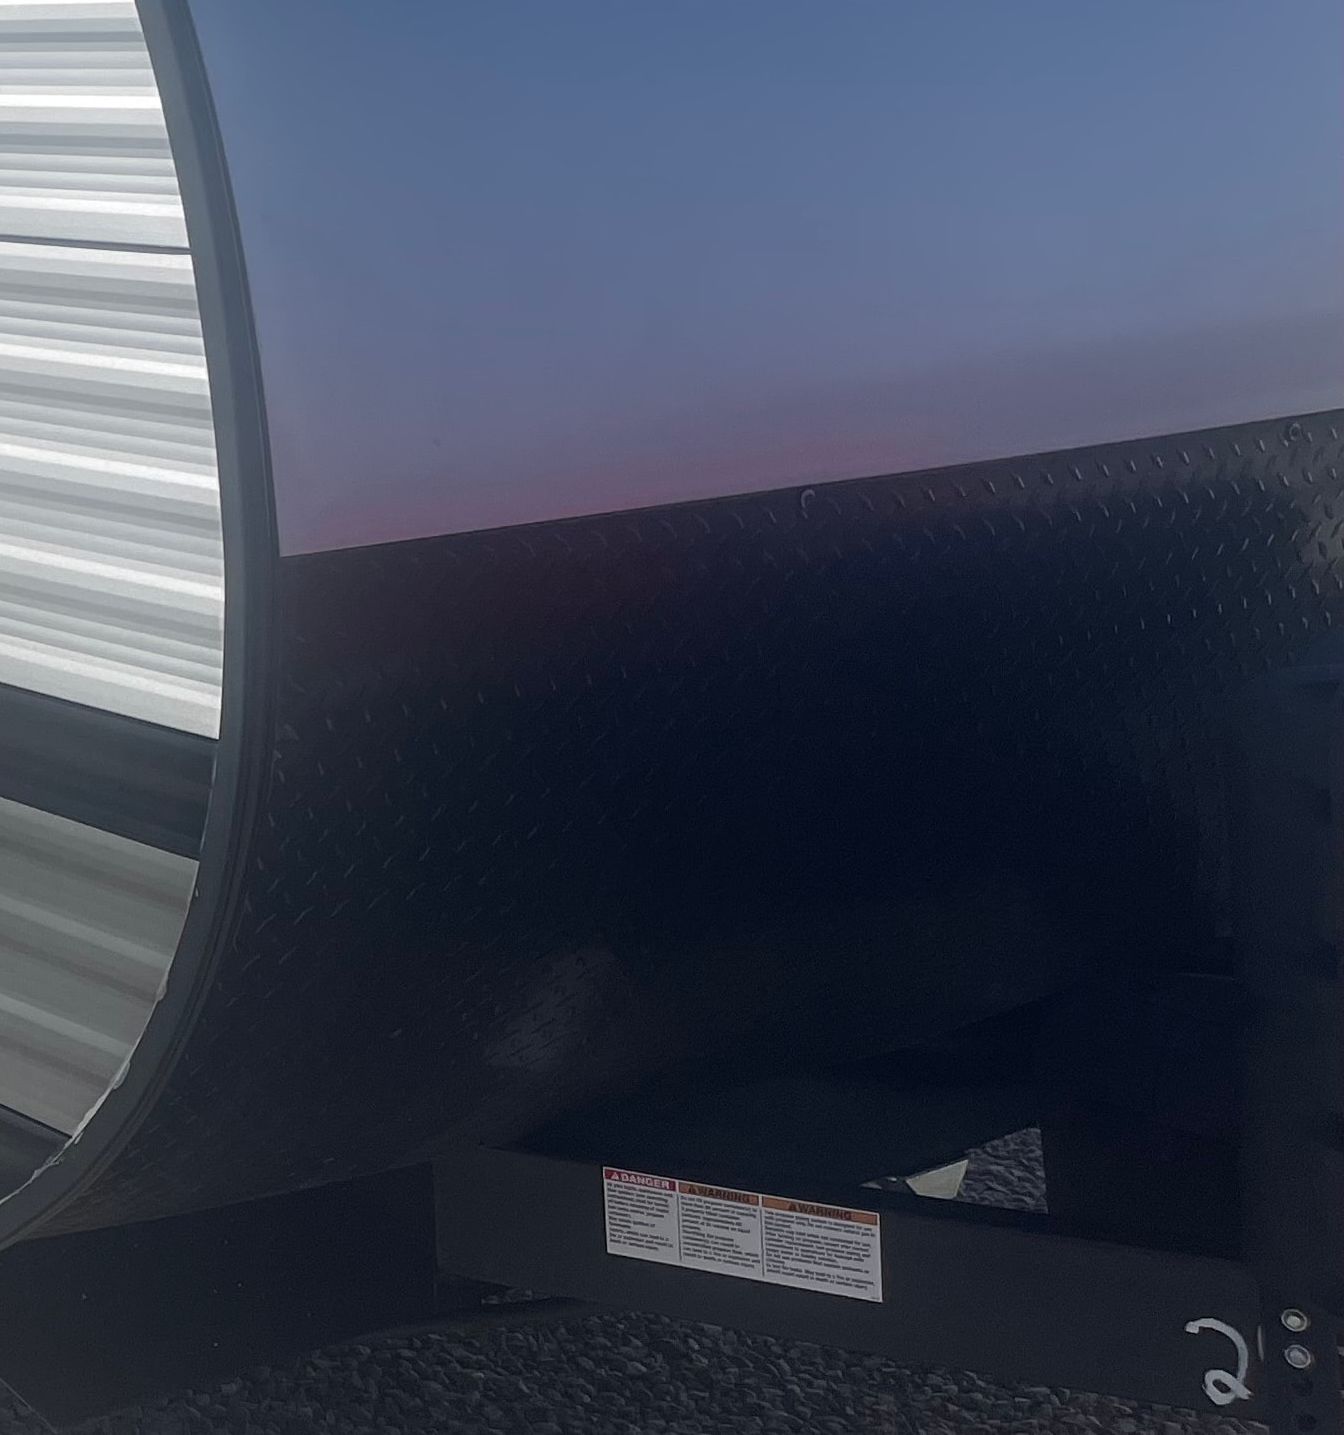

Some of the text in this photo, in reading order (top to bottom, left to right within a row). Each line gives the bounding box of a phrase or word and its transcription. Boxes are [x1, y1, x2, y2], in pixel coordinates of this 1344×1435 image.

[620, 1172, 670, 1190] DANGER
[698, 1186, 751, 1204] WARNING
[797, 1203, 853, 1221] WARNING
[1185, 1318, 1253, 1406] 2
